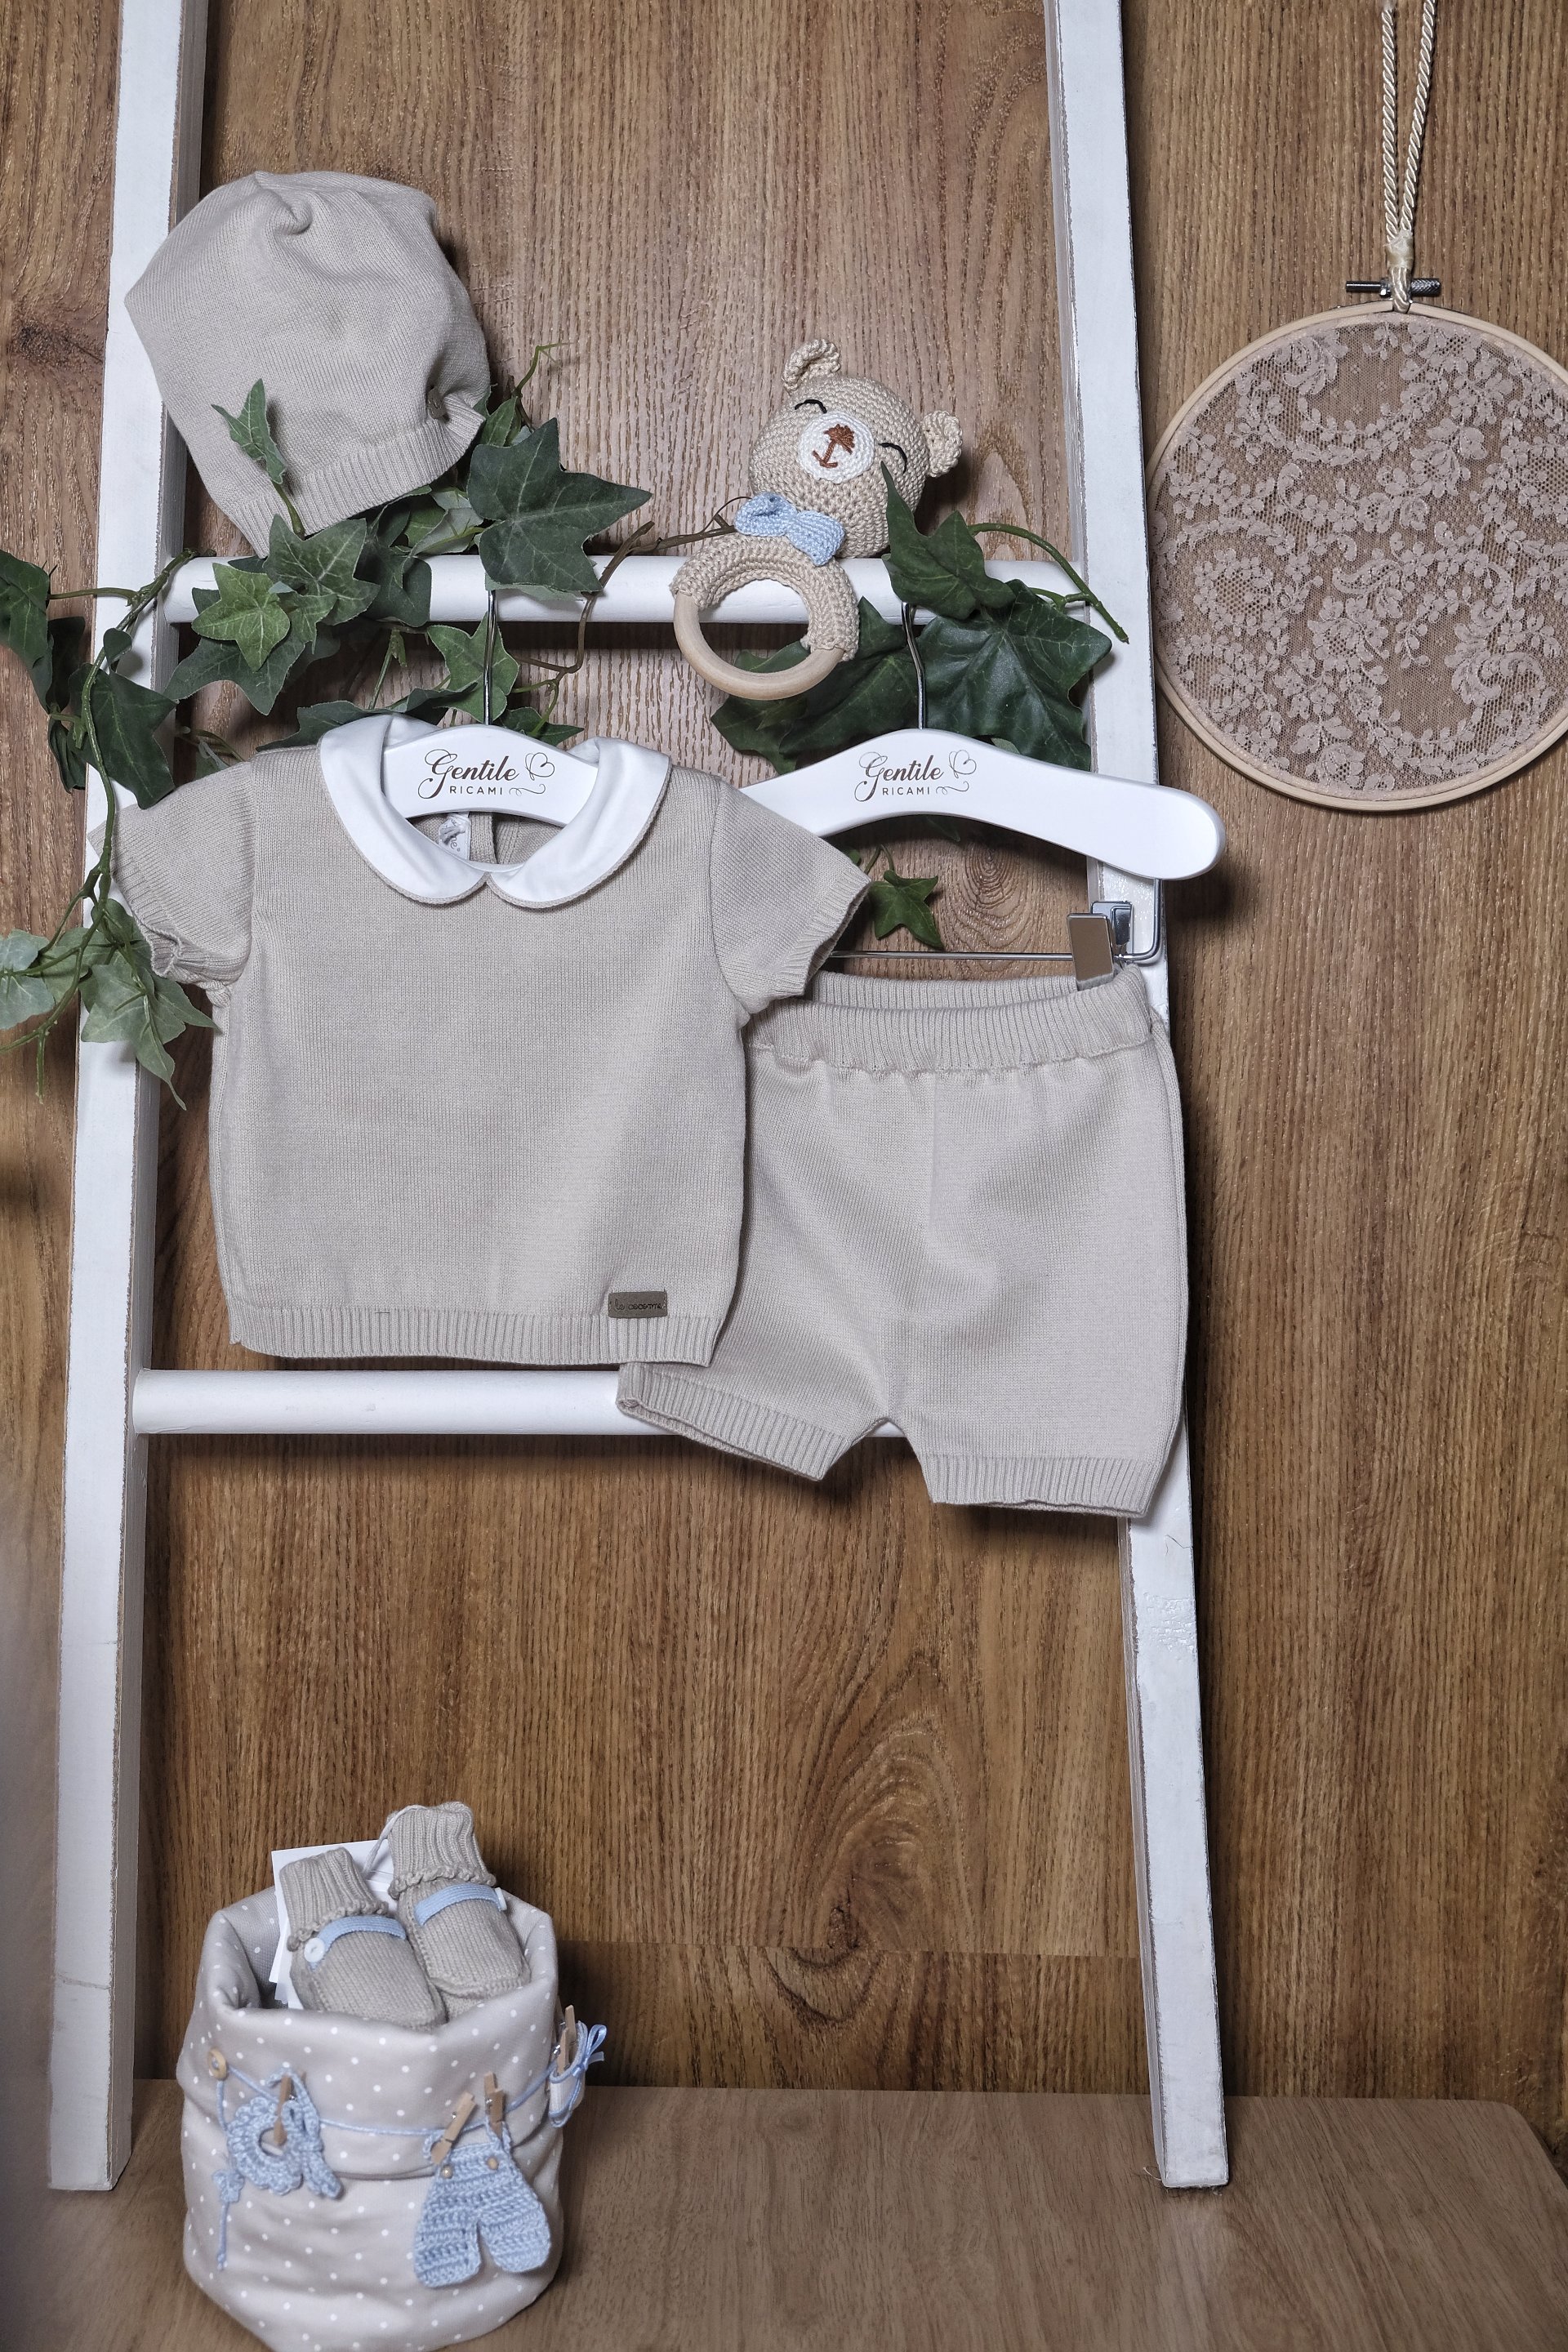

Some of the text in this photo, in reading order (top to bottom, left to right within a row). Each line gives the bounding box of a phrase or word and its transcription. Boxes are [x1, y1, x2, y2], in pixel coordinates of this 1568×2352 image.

[418, 749, 519, 799] Gentile
[854, 751, 945, 802] Gentile
[449, 785, 503, 795] RICAMI
[882, 786, 930, 795] RICAMI
